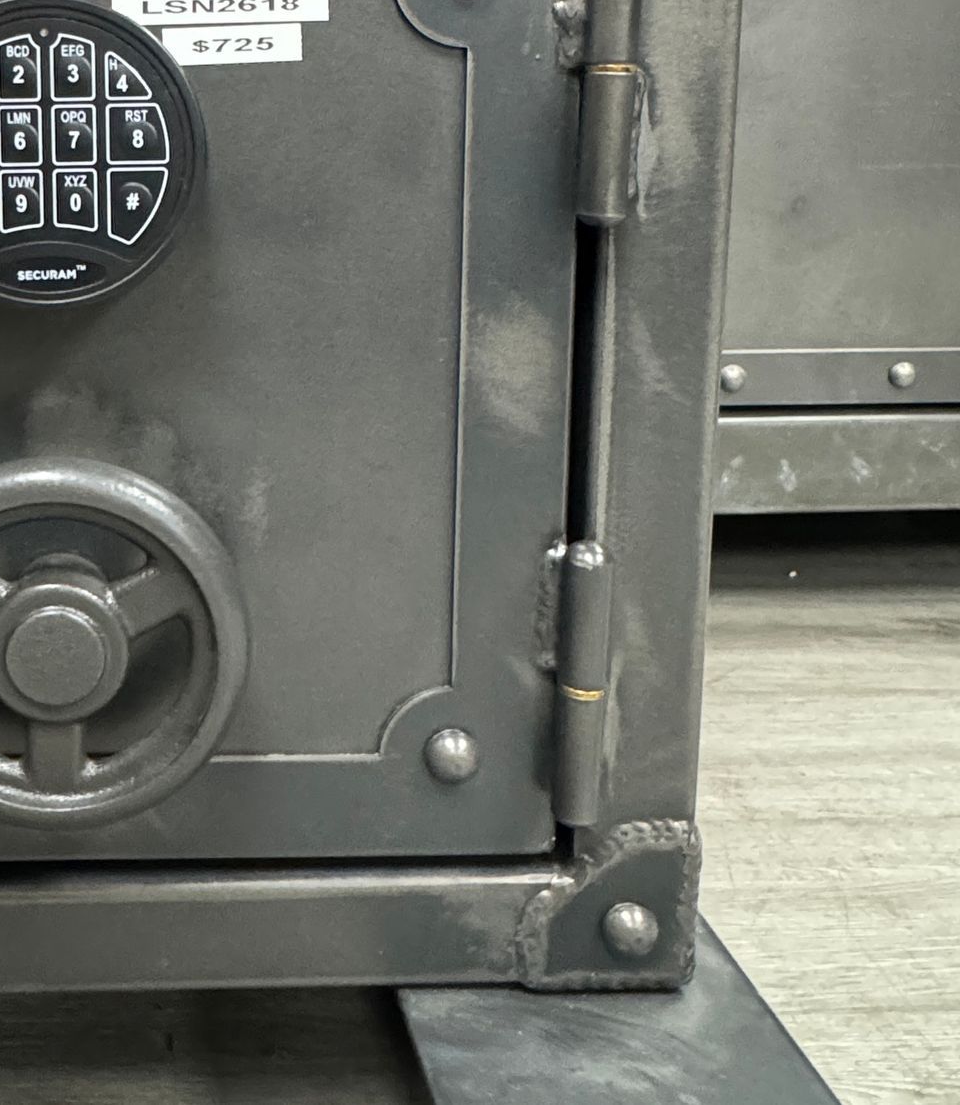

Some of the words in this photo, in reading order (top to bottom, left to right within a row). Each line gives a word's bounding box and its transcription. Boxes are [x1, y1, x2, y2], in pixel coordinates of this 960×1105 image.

[6, 46, 30, 58] BCD
[61, 45, 85, 57] EFG
[192, 37, 274, 53] $725
[109, 59, 118, 70] H
[13, 66, 25, 84] 2
[67, 64, 80, 83] 3
[116, 74, 129, 92] 4
[7, 112, 31, 124] LMN
[61, 112, 86, 125] OPQ
[125, 110, 148, 122] RST
[14, 132, 26, 150] 6
[68, 131, 81, 149] 7
[132, 130, 144, 148] 8
[8, 176, 35, 188] UVW
[64, 175, 87, 187] XYZ
[15, 195, 28, 212] 9
[69, 193, 82, 211] 0
